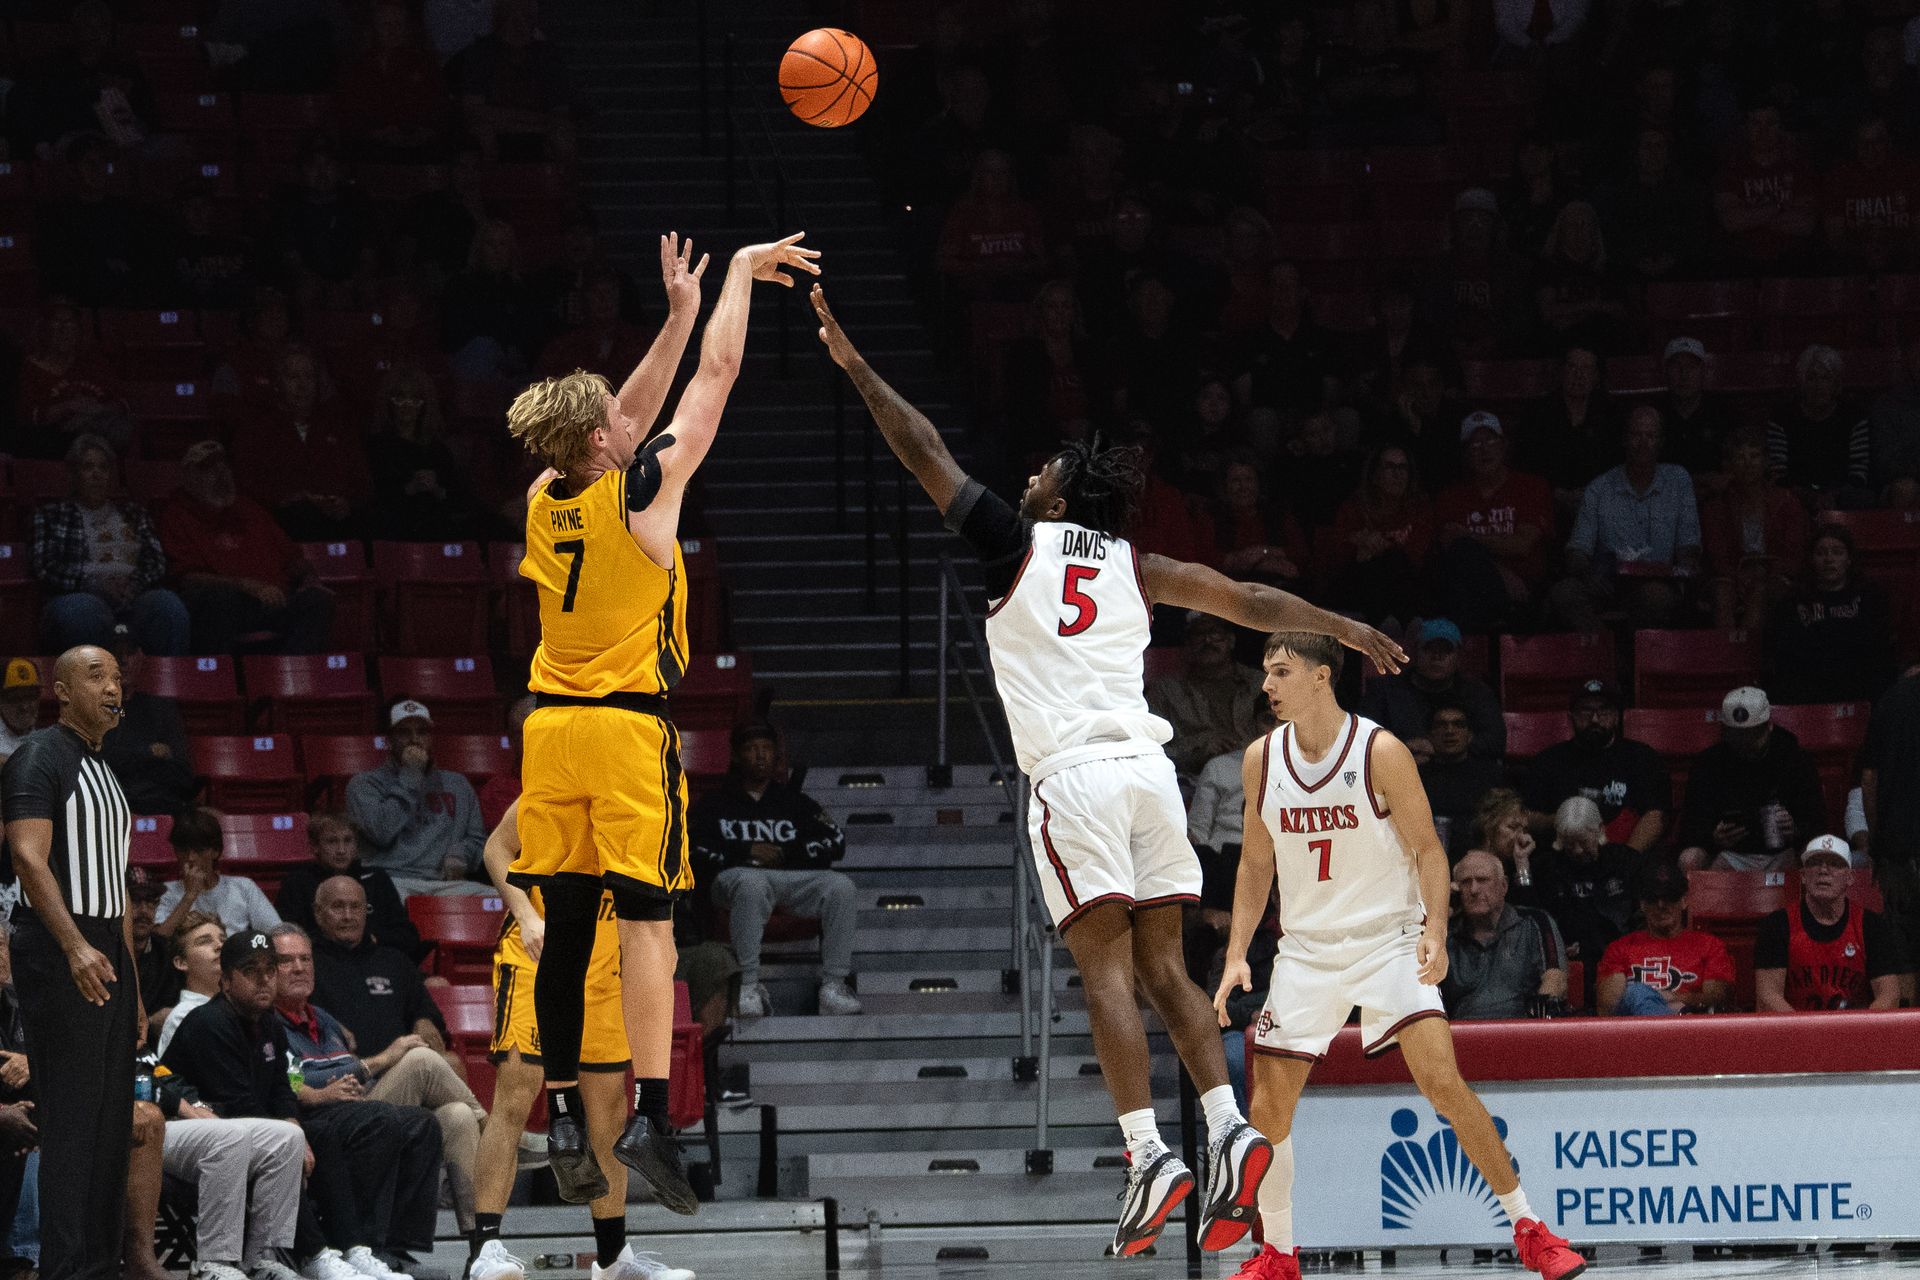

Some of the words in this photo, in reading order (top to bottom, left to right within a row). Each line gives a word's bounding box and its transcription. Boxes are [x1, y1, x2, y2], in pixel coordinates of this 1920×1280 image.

[551, 507, 585, 532] PAYNE
[1063, 530, 1106, 560] DAVIS
[554, 539, 586, 613] 7
[1058, 564, 1101, 637] 5
[719, 818, 798, 843] KING
[1279, 804, 1360, 834] AZTECS
[1308, 838, 1333, 882] 7
[1554, 1128, 1698, 1169] KAISER
